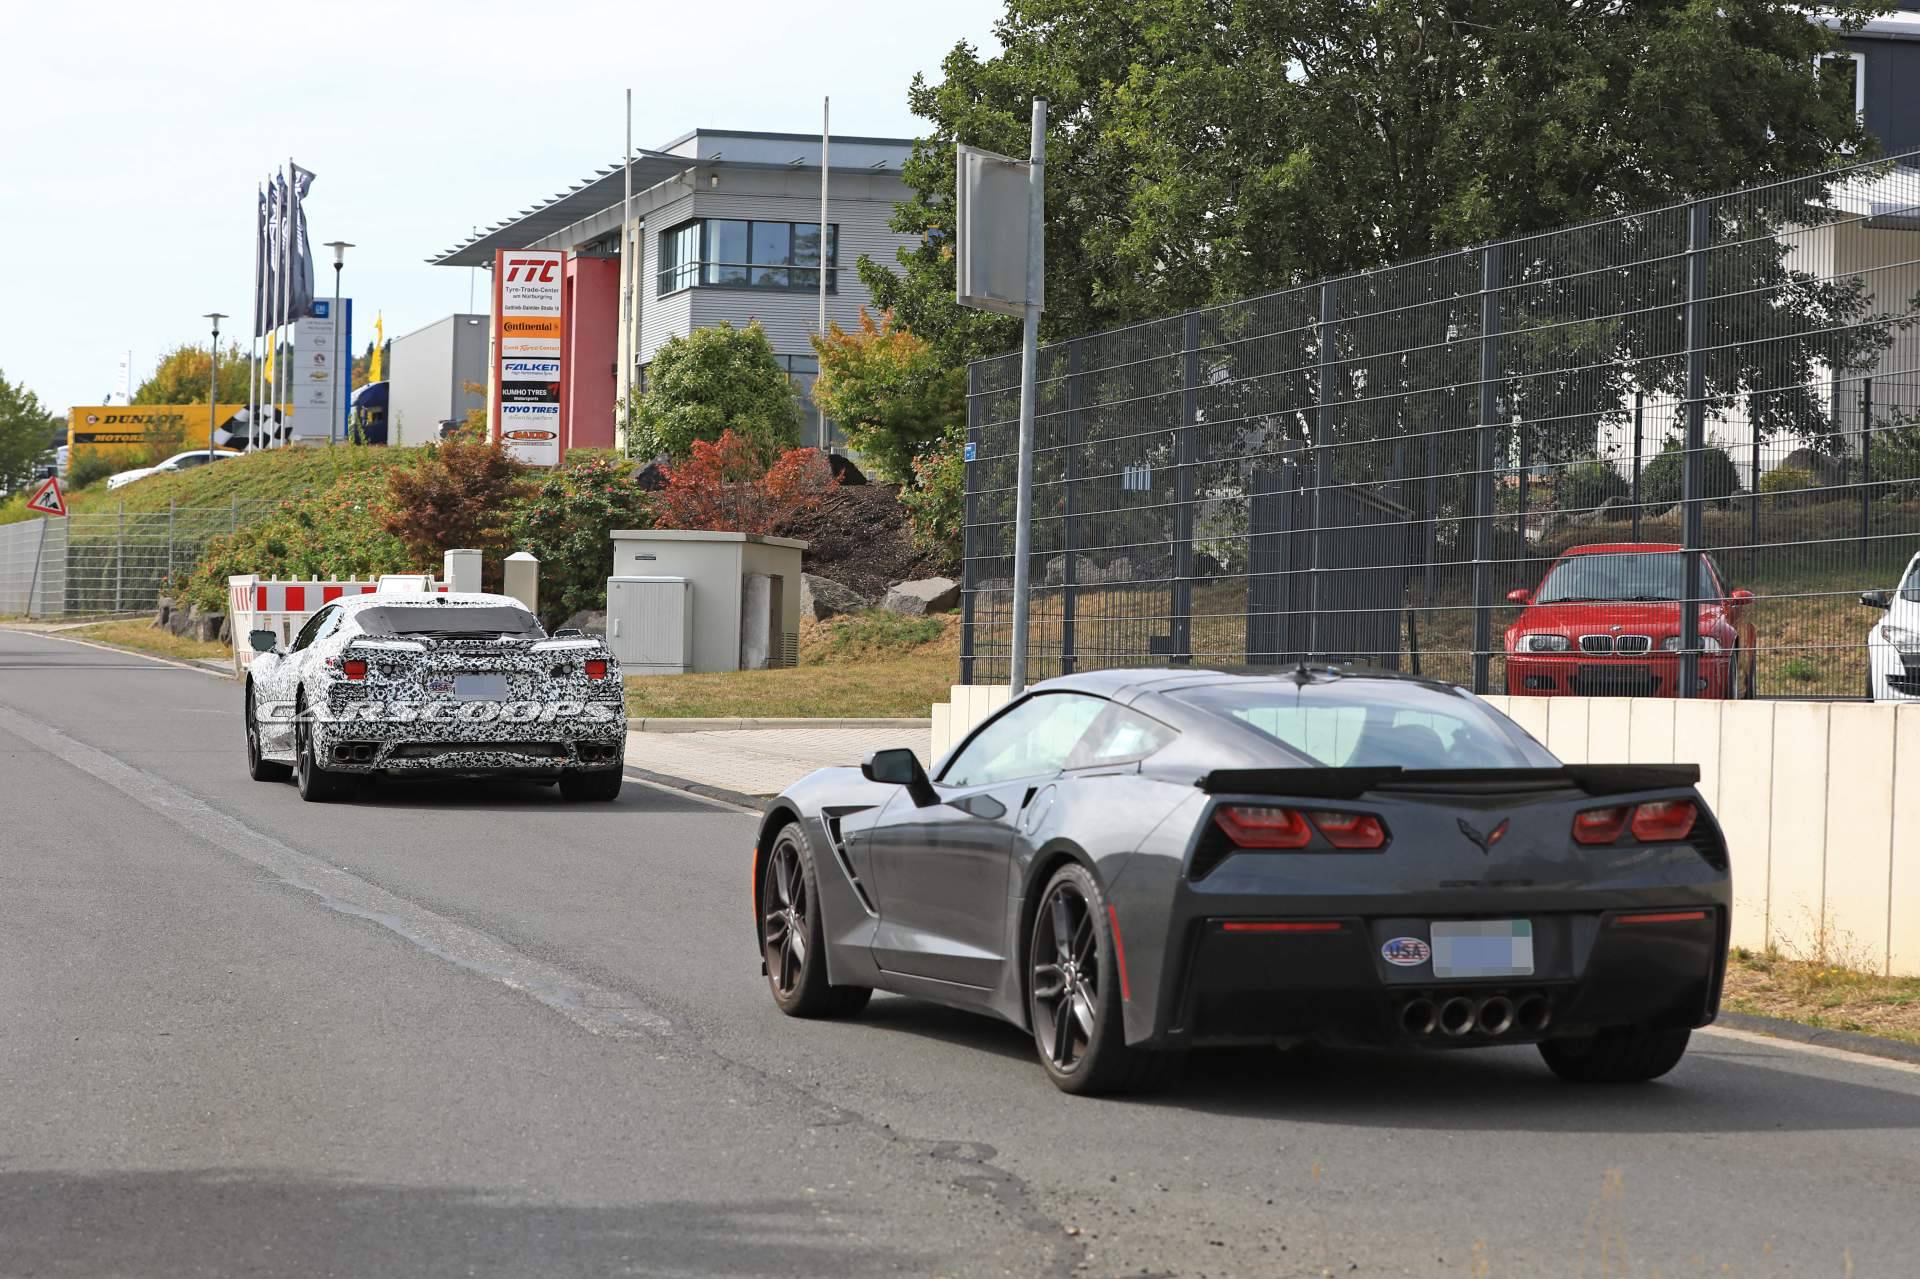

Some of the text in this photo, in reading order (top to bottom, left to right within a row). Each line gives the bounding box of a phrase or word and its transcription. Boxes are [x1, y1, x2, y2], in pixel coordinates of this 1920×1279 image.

[507, 259, 559, 282] TTC
[504, 322, 552, 332] Continental
[505, 363, 559, 371] FALKEN
[1390, 941, 1422, 957] USA
